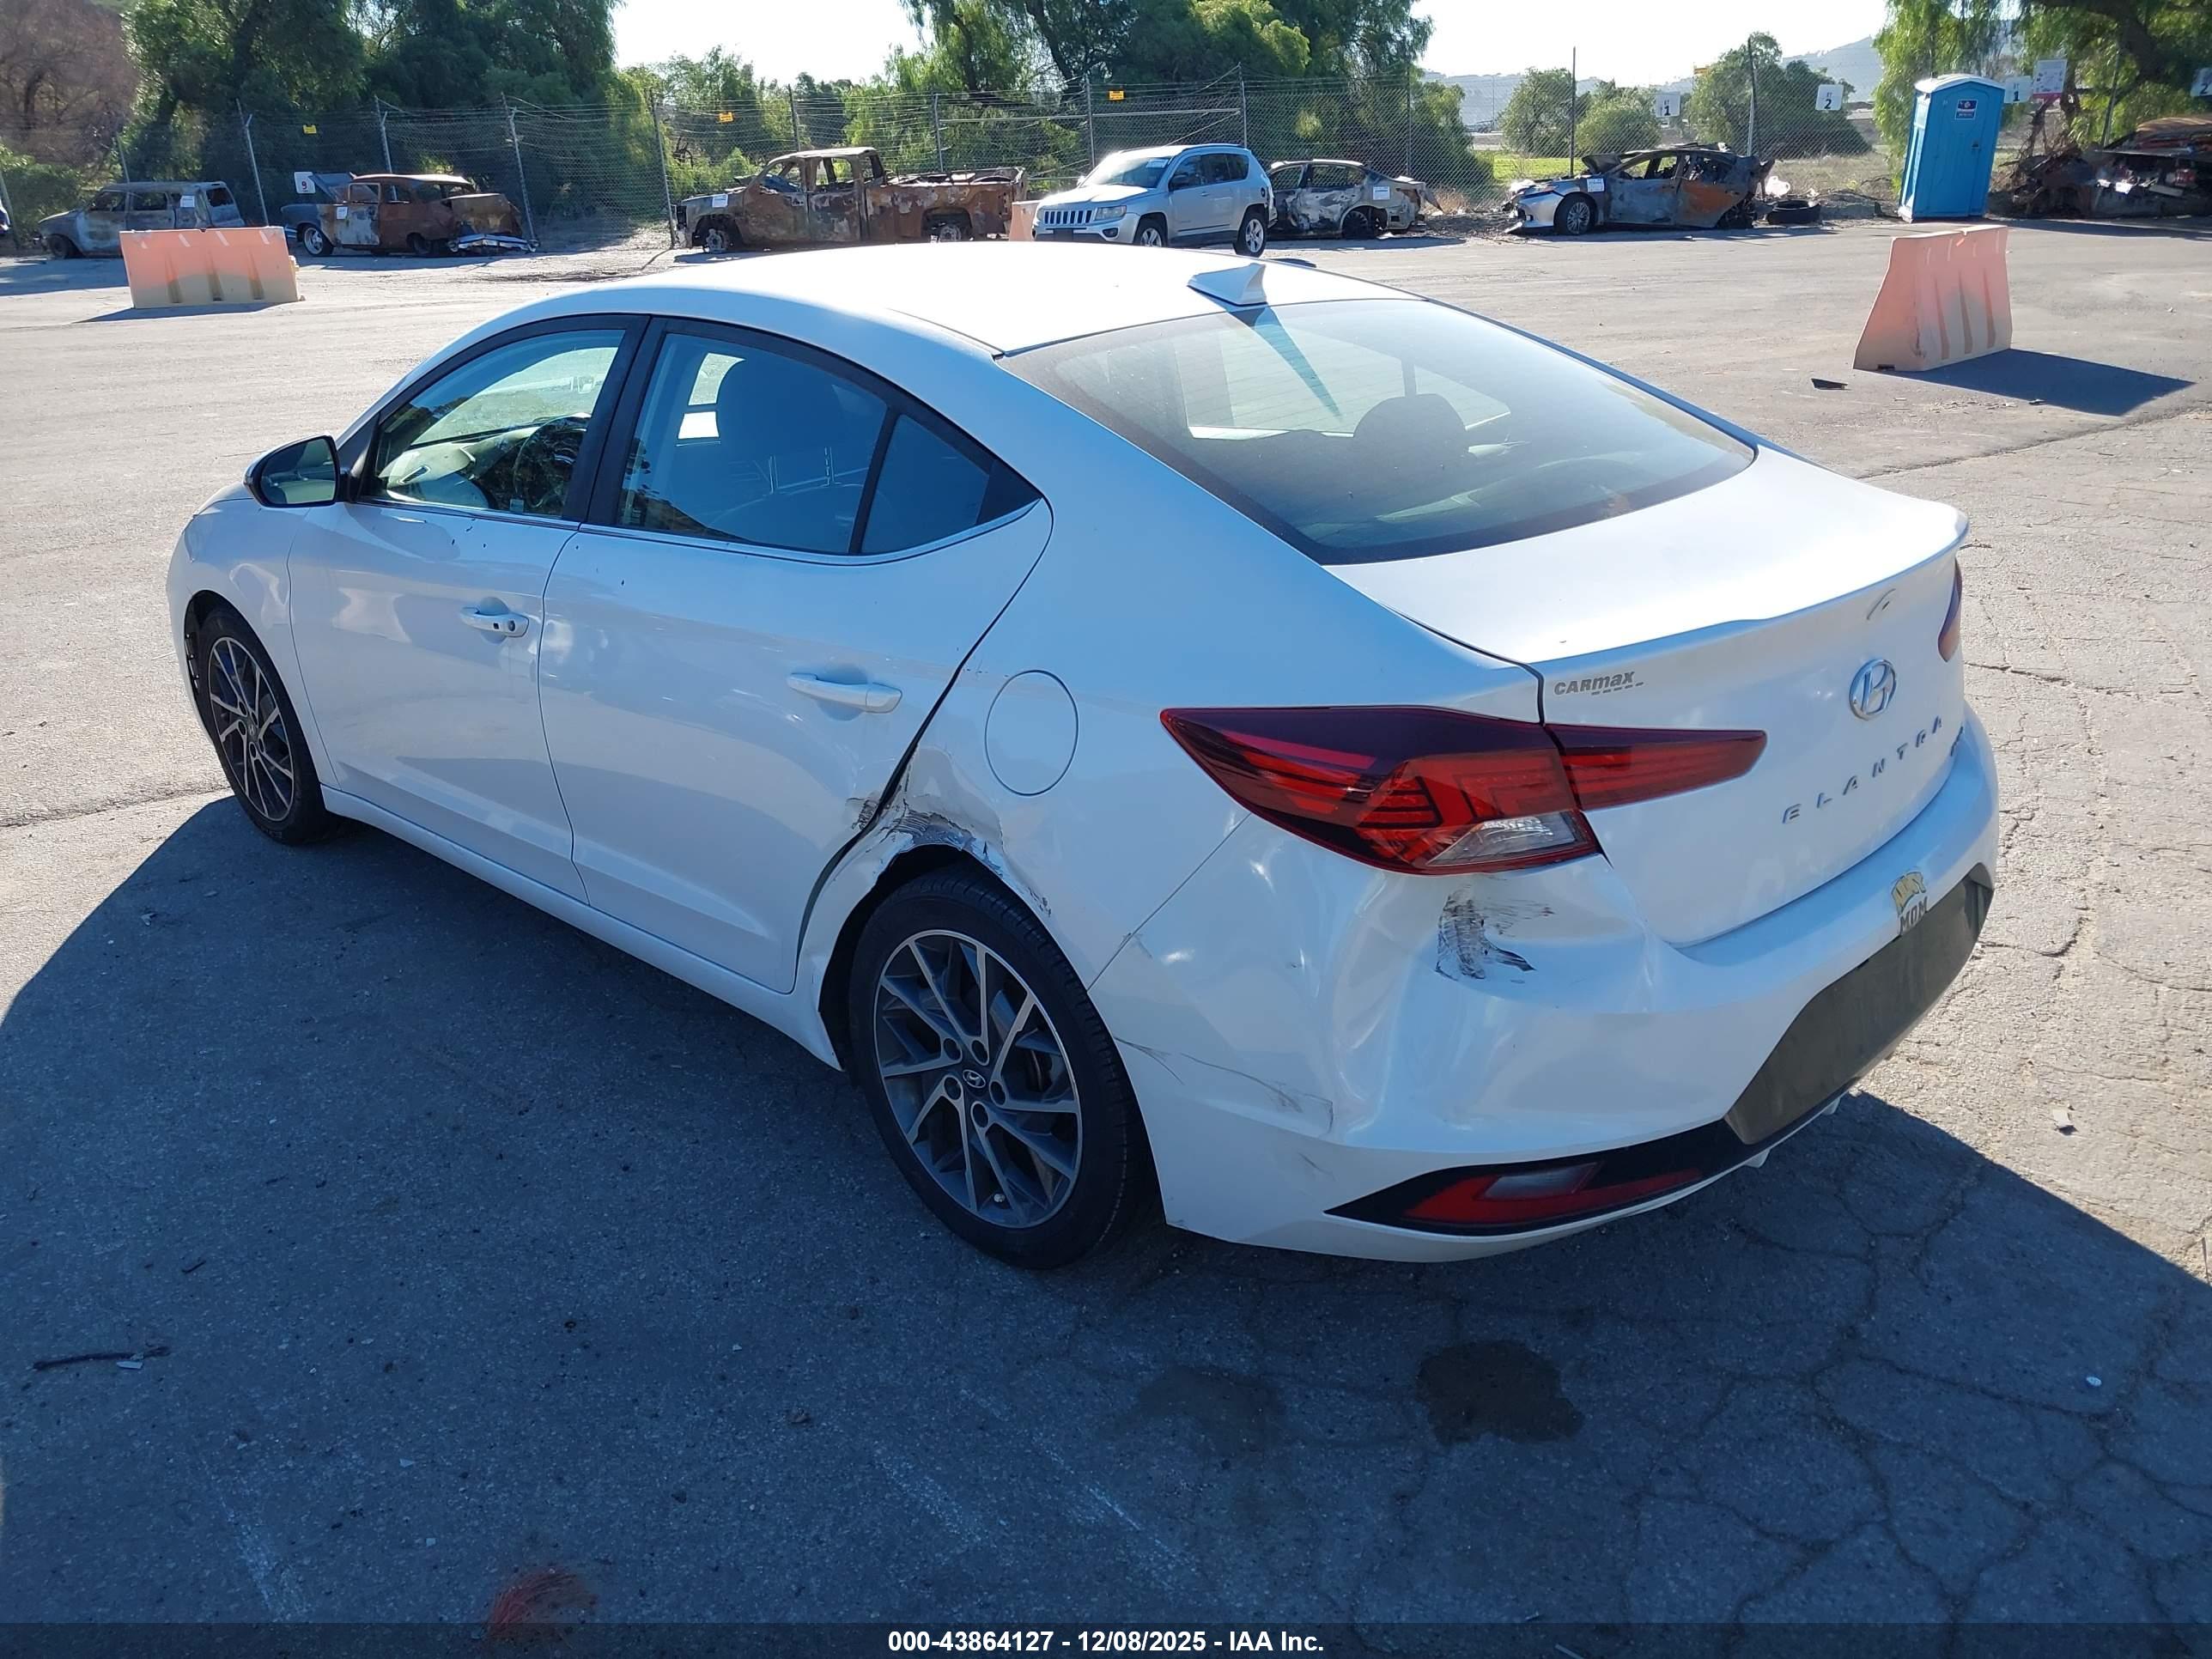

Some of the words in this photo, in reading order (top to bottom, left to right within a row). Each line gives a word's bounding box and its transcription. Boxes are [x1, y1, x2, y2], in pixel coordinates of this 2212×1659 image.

[2013, 90, 2021, 101] 1
[1824, 99, 1832, 109] 2
[1664, 105, 1671, 116] 1
[301, 180, 307, 190] 9
[1782, 715, 1942, 824] ELANTRA
[1899, 896, 1928, 935] MOM
